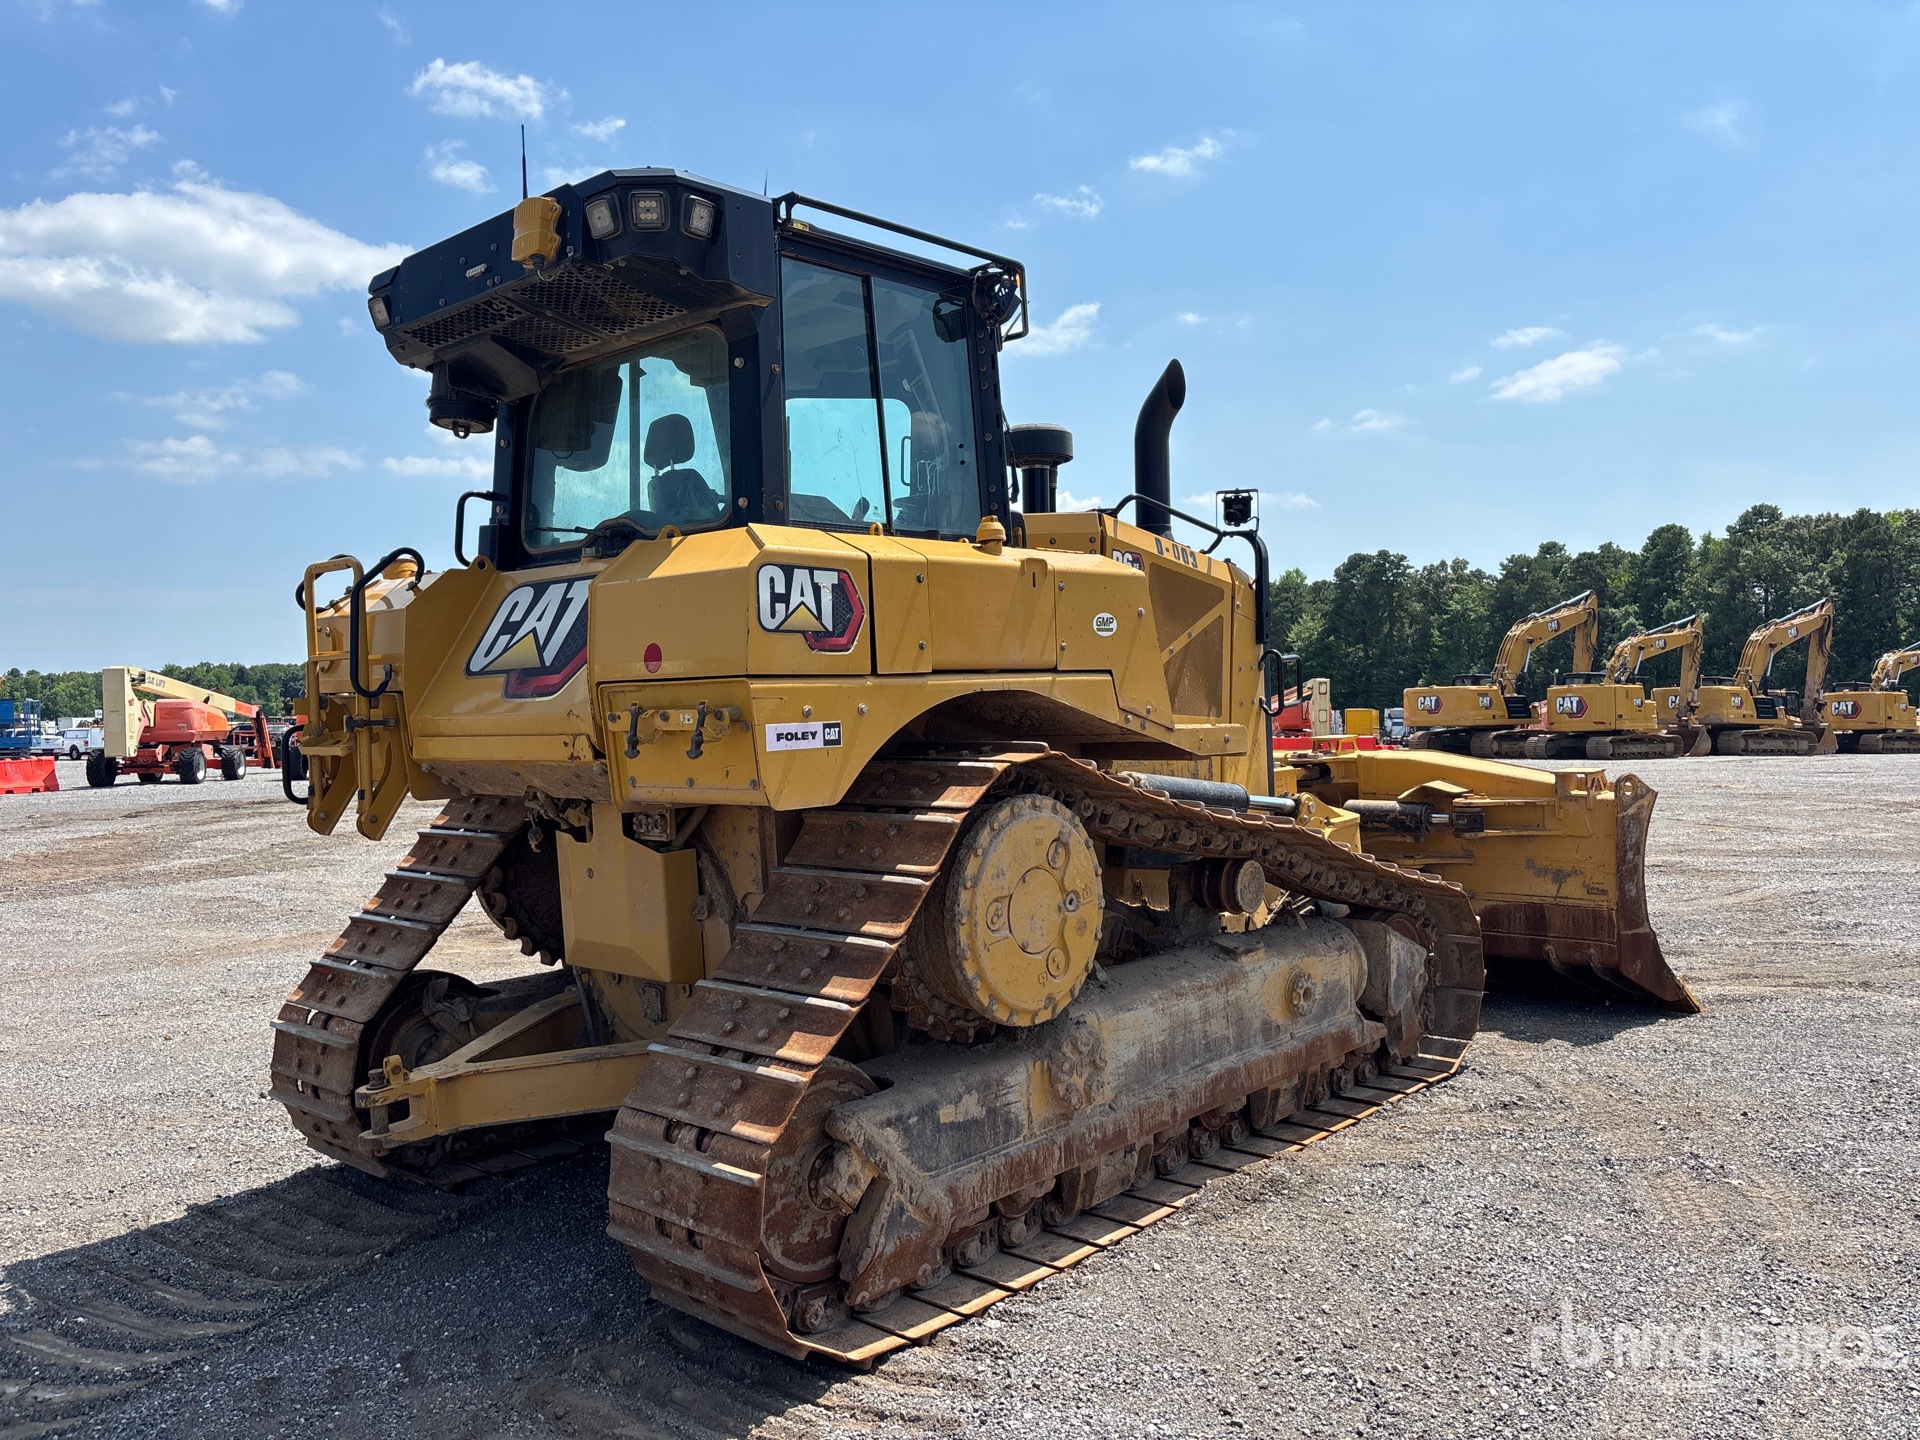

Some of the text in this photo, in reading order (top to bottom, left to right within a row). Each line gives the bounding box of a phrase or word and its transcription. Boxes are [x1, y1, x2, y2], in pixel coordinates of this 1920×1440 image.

[758, 565, 838, 632] CAT
[469, 579, 592, 672] CAT
[1096, 617, 1114, 627] GMP
[1547, 620, 1559, 632] CAT
[1418, 696, 1437, 711] CAT
[1479, 697, 1491, 707] CAT
[1556, 697, 1579, 714] CAT
[1668, 695, 1680, 709] CA
[1832, 701, 1854, 715] CAT
[776, 728, 840, 742] FOLEY CAT
